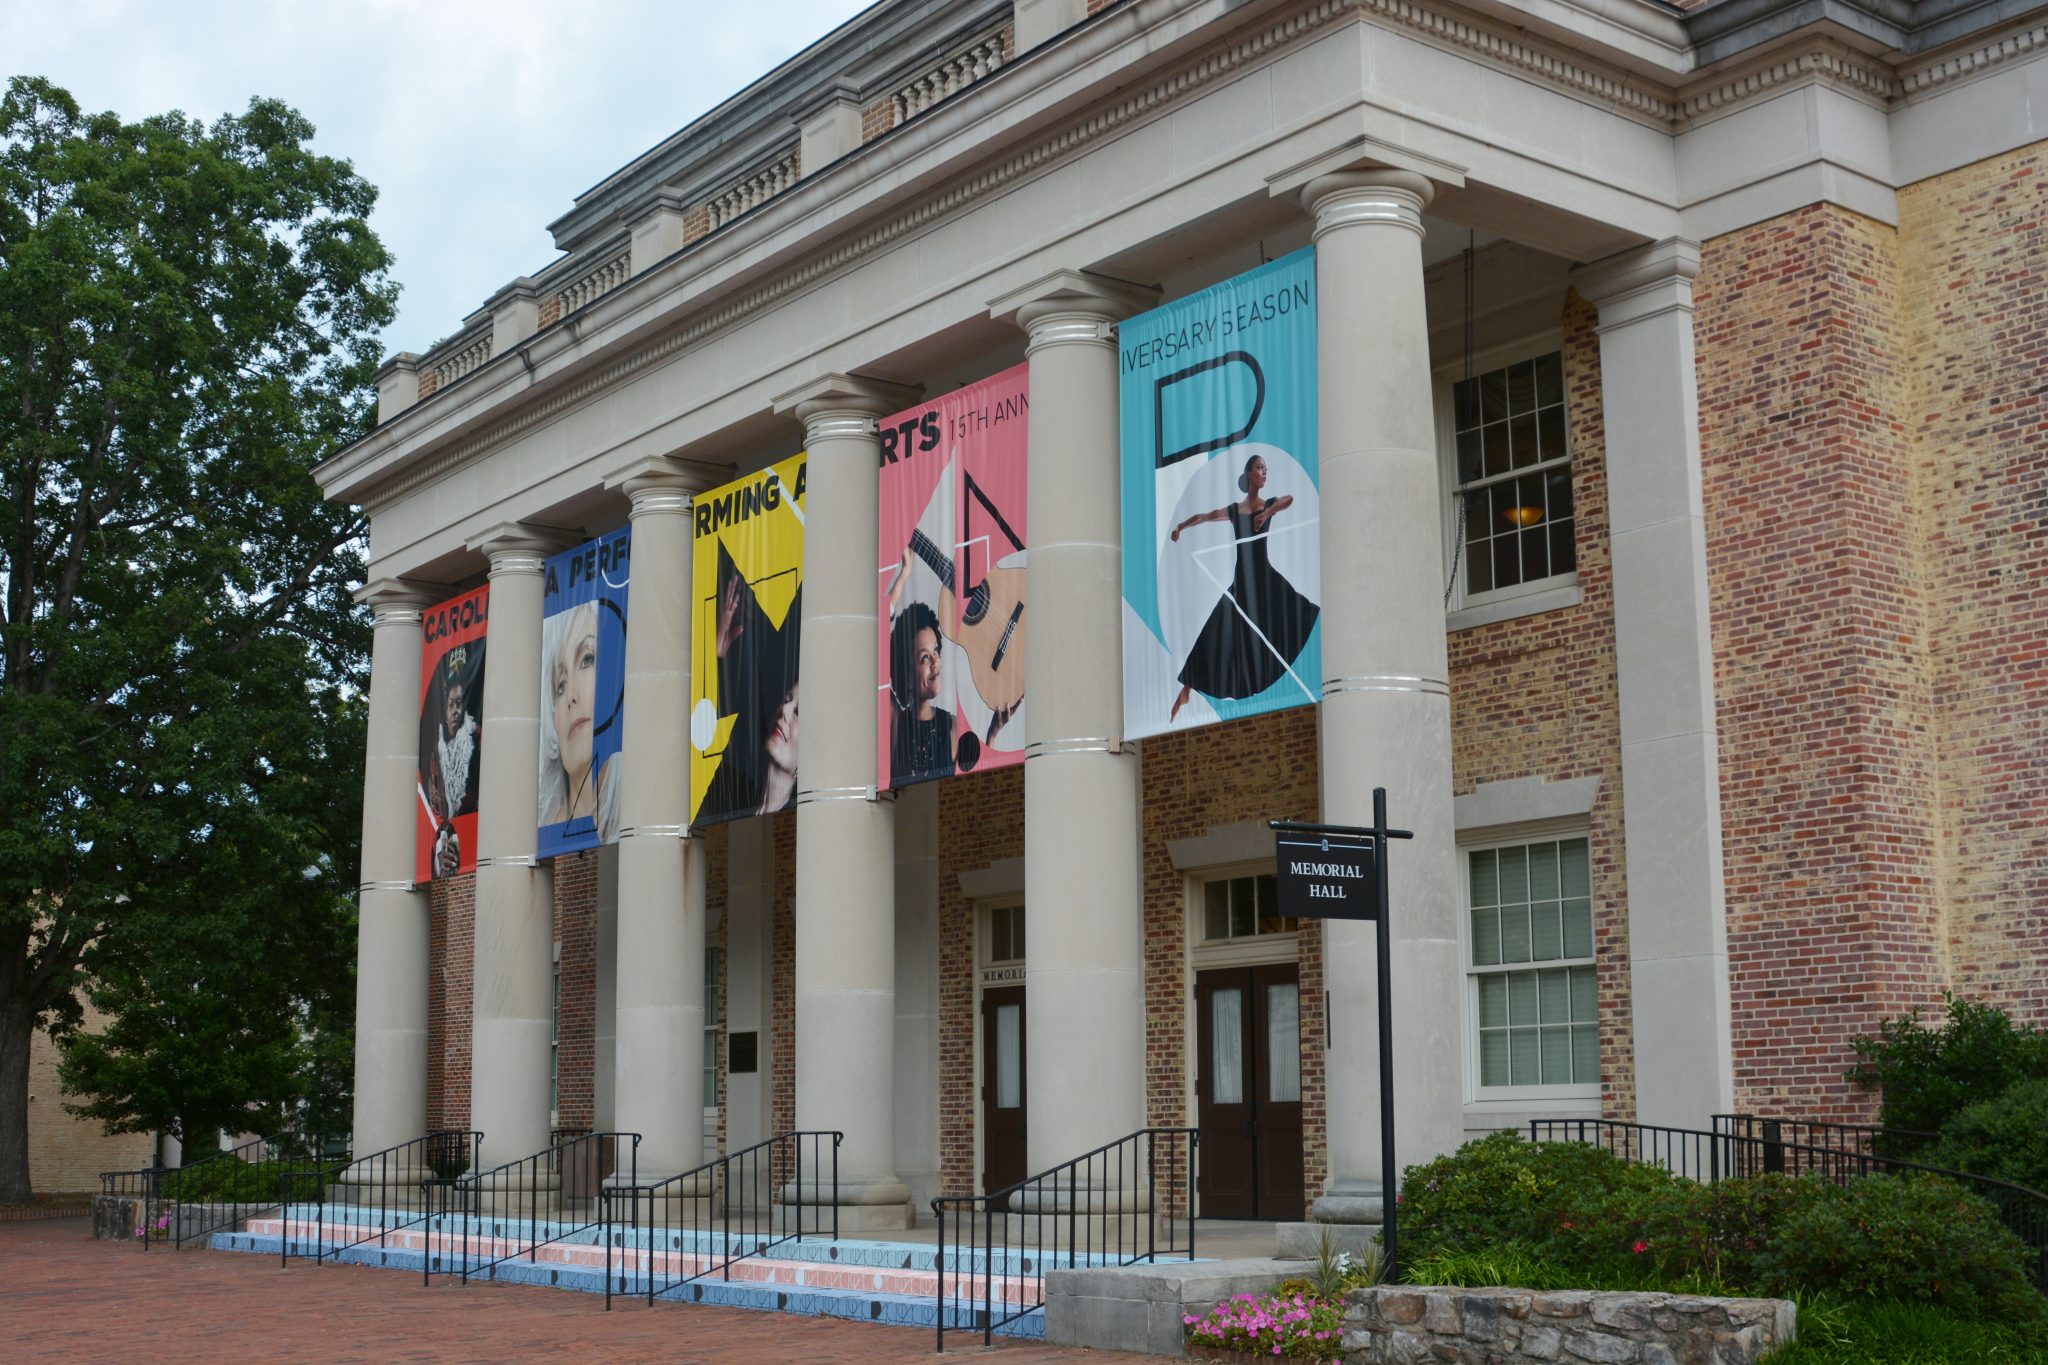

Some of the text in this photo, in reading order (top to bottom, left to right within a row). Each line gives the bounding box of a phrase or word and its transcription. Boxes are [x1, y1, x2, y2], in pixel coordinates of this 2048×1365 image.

[1121, 279, 1309, 375] IVERSARY SEASON
[880, 411, 941, 468] RTS
[950, 407, 988, 441] 15TH
[695, 475, 780, 539] RMING
[1290, 862, 1364, 878] MEMORIAL
[1309, 885, 1347, 899] HALL
